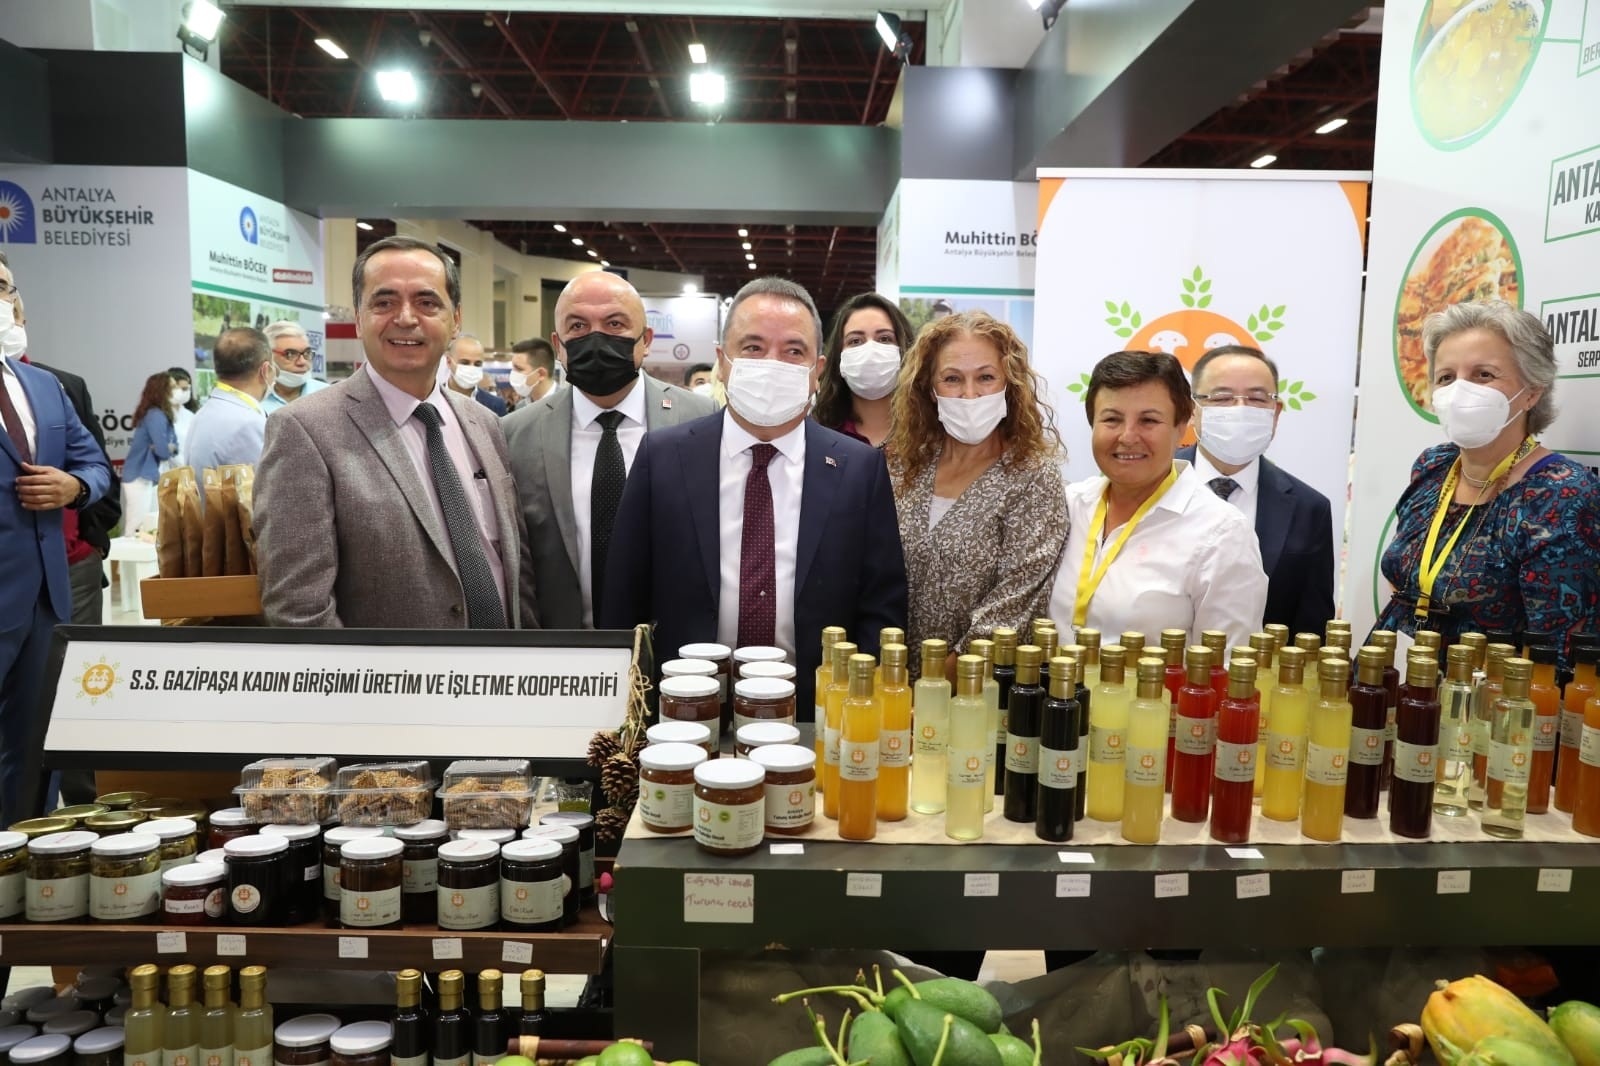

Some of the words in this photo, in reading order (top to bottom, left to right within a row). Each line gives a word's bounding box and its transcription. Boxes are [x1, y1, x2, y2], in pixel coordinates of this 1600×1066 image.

[41, 187, 116, 203] ANTALYA
[42, 205, 154, 226] BÜYÜKŞEHİR
[44, 228, 131, 247] BELEDİYESİ
[945, 231, 1016, 246] Muhittin
[209, 250, 242, 268] Muhittin
[243, 257, 268, 275] BÖCEK
[1546, 307, 1600, 345] ANTAL
[129, 669, 159, 691] S.S.
[163, 666, 238, 695] GAZİPAŞA
[242, 671, 290, 693] KADIN
[292, 667, 361, 696] GİRİŞİMİ
[362, 668, 422, 694] ÜRETİM
[425, 674, 445, 695] VE
[447, 670, 514, 698] İŞLETME
[517, 672, 619, 697] KOOPERATİFİ
